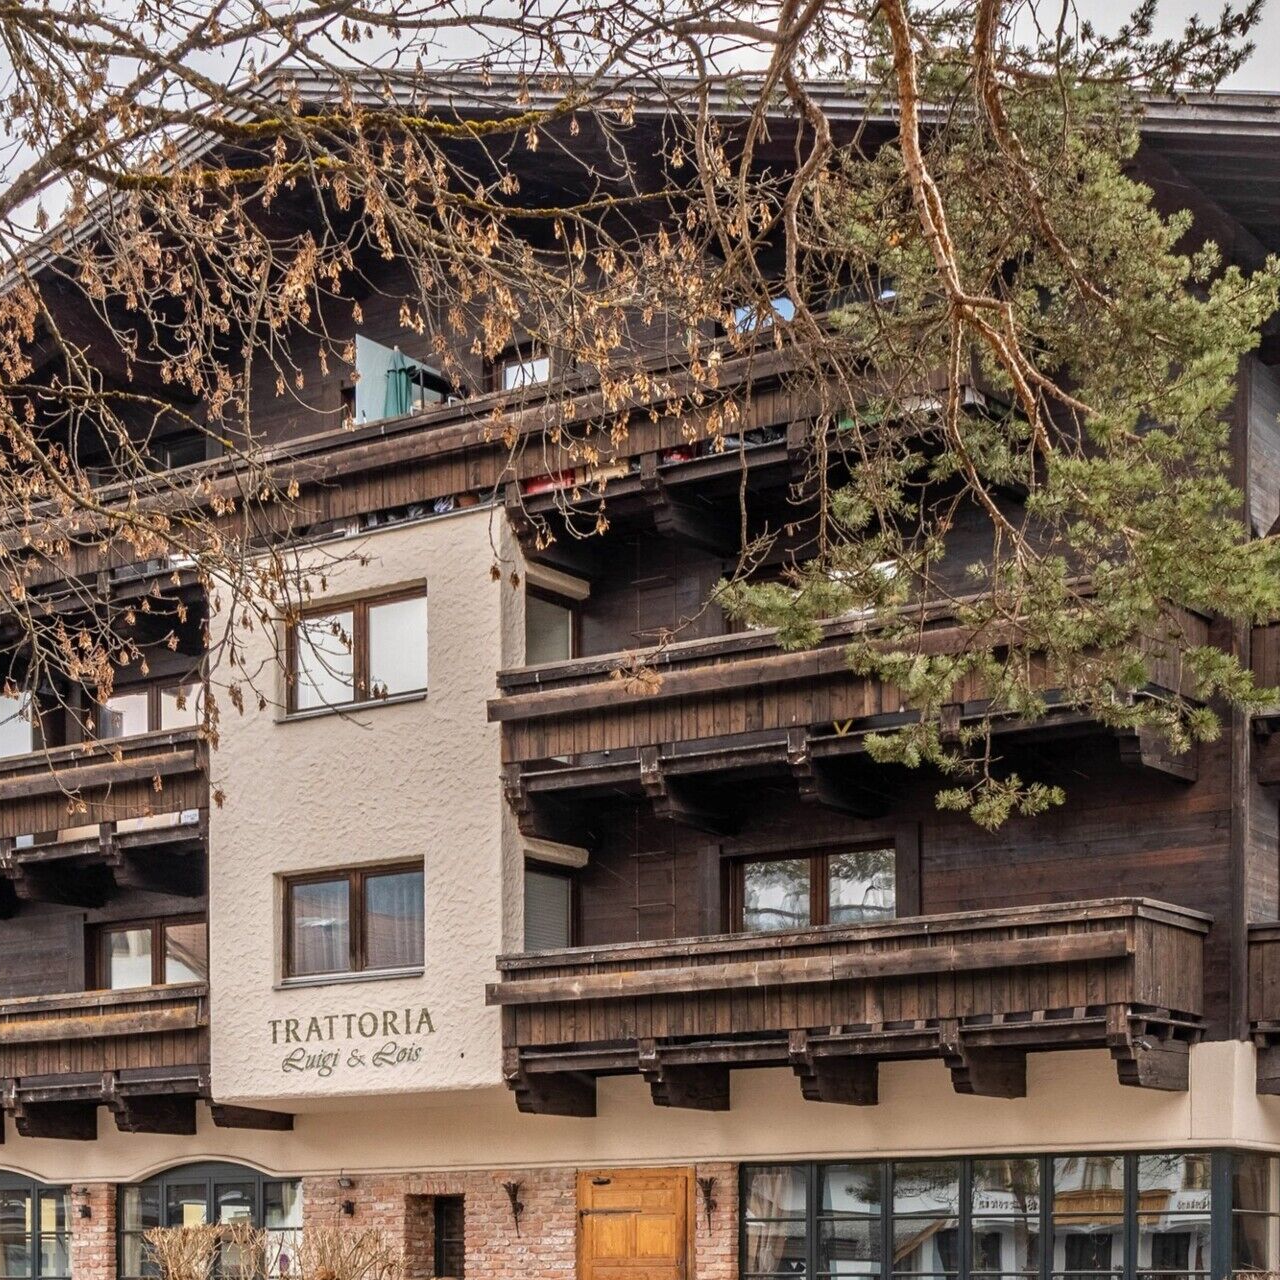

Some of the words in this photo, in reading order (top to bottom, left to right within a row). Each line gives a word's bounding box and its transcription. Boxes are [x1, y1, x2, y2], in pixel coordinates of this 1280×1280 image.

[268, 1007, 436, 1044] TRATTORIA
[282, 1047, 340, 1077] Luigi
[347, 1049, 365, 1068] &
[372, 1041, 422, 1067] Lois
